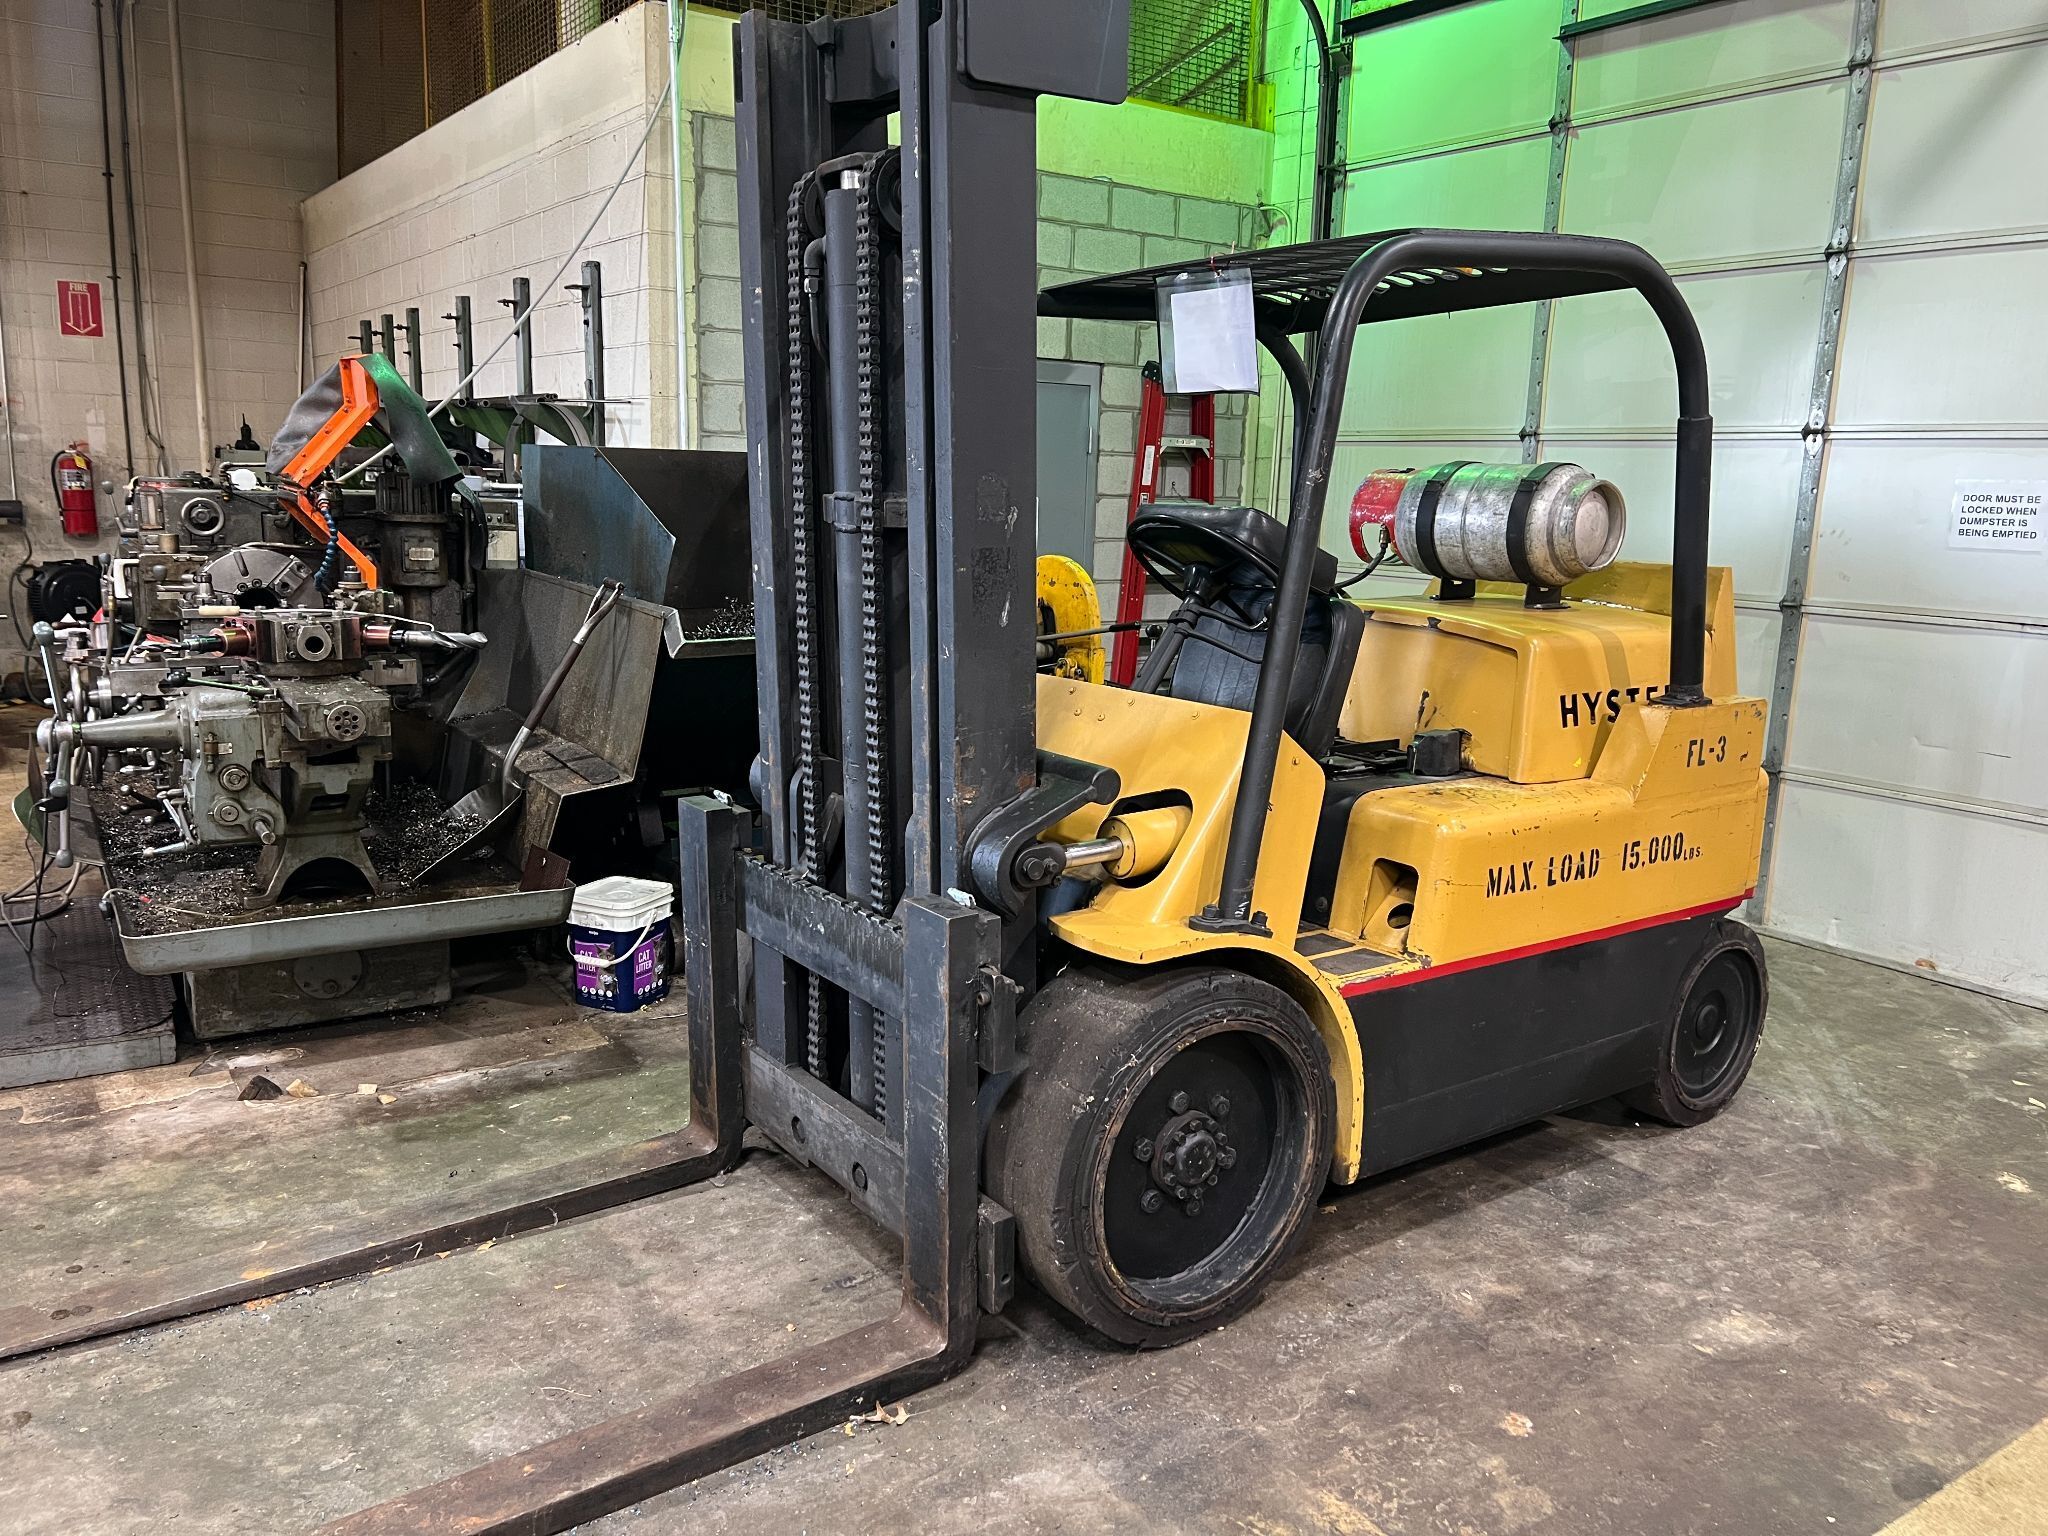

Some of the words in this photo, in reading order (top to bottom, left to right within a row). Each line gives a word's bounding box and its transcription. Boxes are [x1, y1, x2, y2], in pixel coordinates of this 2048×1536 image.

[70, 282, 88, 291] FIRE
[1963, 494, 1993, 503] DOOR
[1995, 495, 2025, 503] MUST
[2027, 495, 2042, 504] BE
[1961, 505, 2003, 515] LOCKED
[2006, 507, 2037, 516] WHEN
[1959, 517, 2016, 527] DUMPSTER
[2018, 519, 2028, 527] IS
[1958, 528, 1989, 537] BEING
[1992, 529, 2037, 539] EMPTIED
[1559, 684, 1670, 728] HYST
[1686, 735, 1727, 768] FL-3
[1486, 860, 1537, 899] MAX.
[1547, 848, 1600, 887] LOAD
[638, 949, 651, 963] CAT
[635, 960, 653, 974] LITTER
